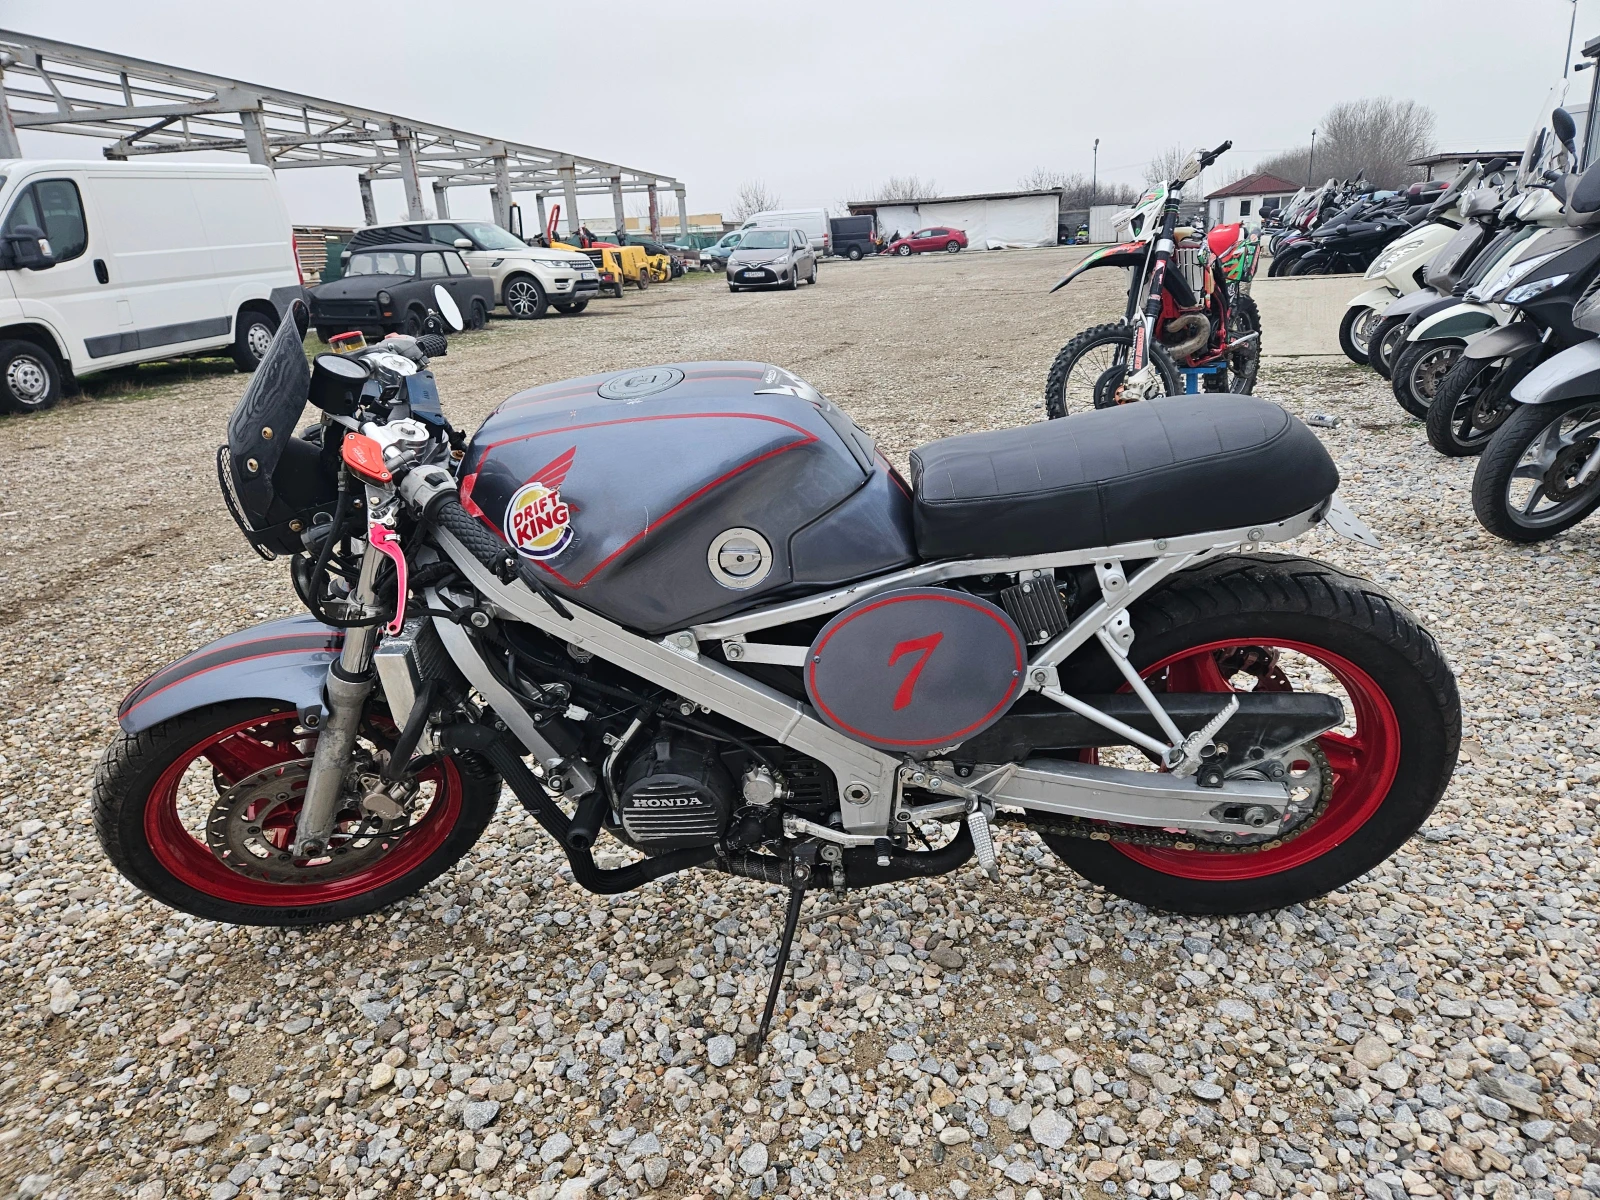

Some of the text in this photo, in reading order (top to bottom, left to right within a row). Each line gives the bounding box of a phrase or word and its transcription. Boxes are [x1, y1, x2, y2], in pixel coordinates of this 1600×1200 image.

[513, 491, 558, 528] DRIFT
[515, 505, 568, 546] KING
[887, 631, 944, 711] 7
[632, 797, 703, 807] HONDA
